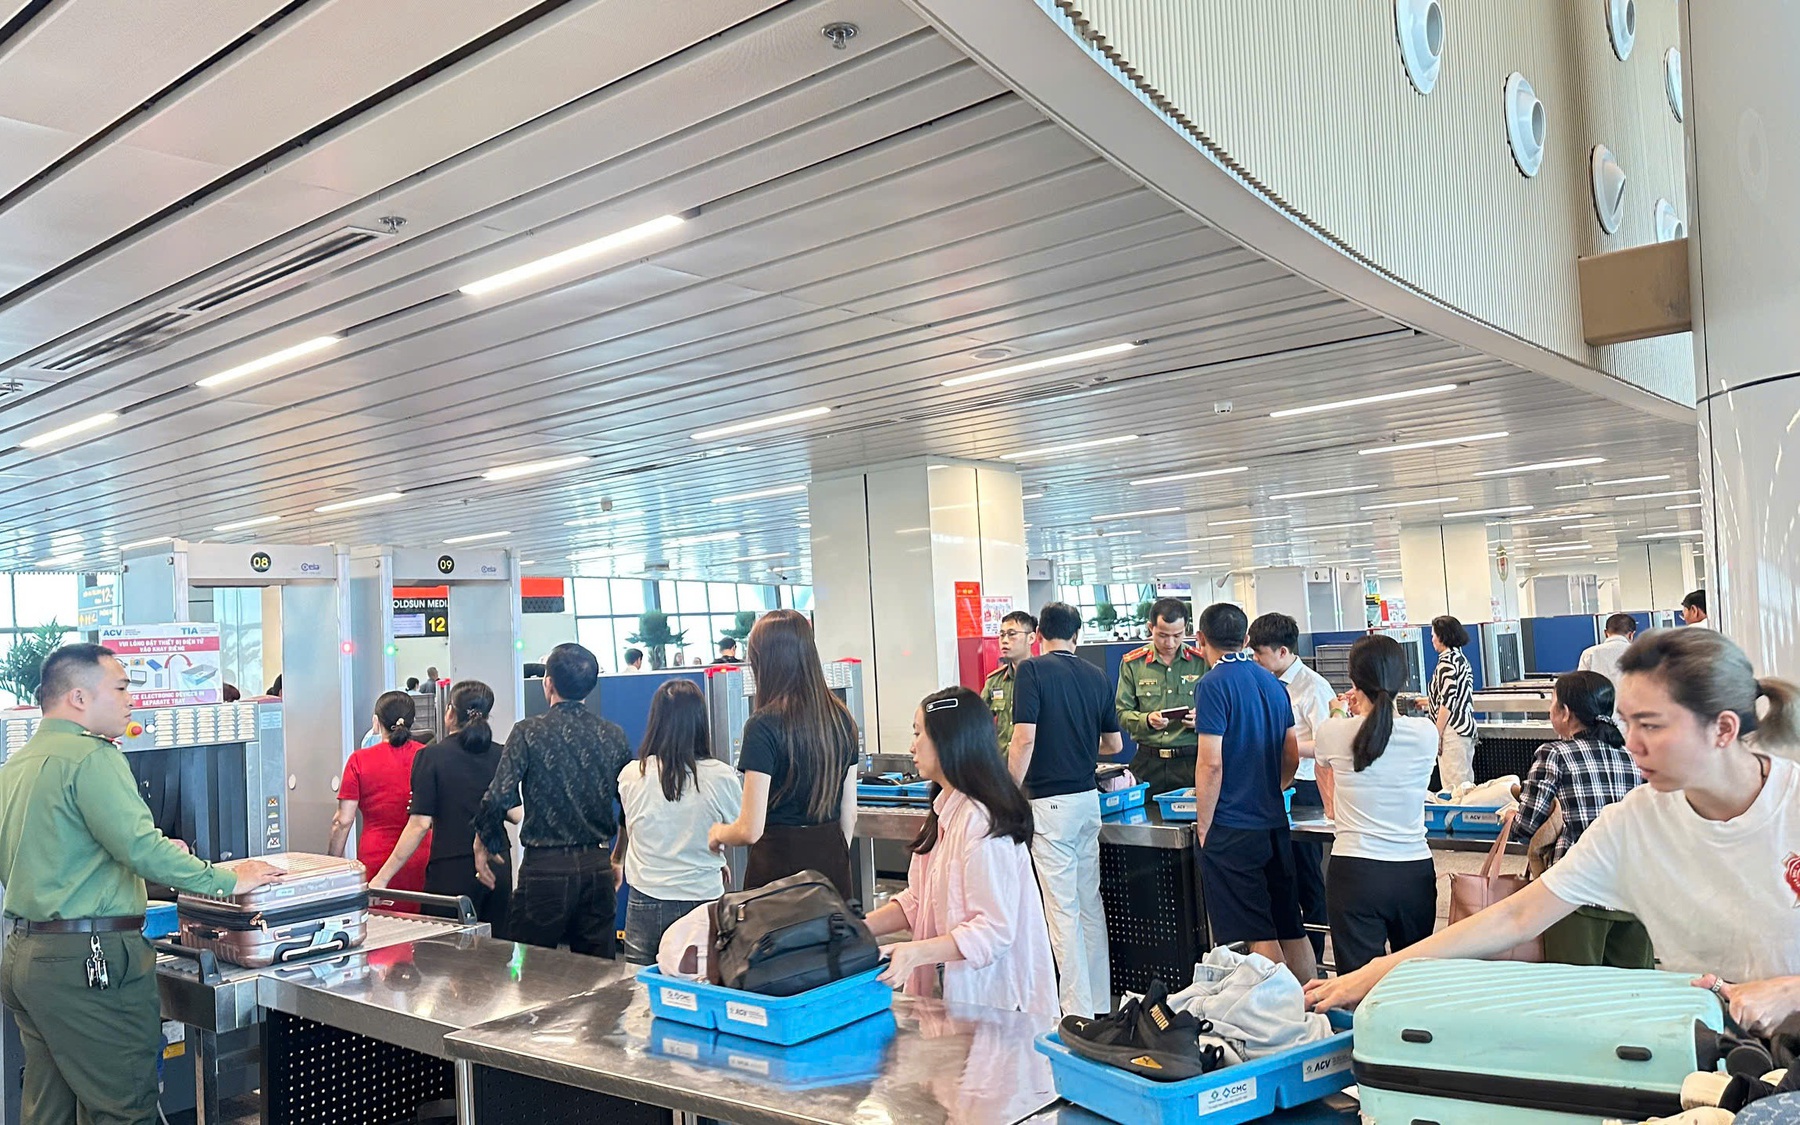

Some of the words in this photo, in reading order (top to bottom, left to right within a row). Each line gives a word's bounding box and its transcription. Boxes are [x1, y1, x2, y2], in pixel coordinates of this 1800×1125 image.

[252, 556, 269, 568] 08
[439, 559, 453, 570] 09
[393, 599, 425, 608] OLDSUN
[427, 599, 449, 608] MEDI
[428, 616, 446, 632] 12
[103, 629, 122, 637] ACV
[181, 627, 198, 635] TIA
[140, 692, 175, 700] ELECTRONIC
[1149, 1003, 1170, 1031] PUMA
[1314, 1058, 1331, 1072] ACV
[1231, 1083, 1248, 1094] CMC
